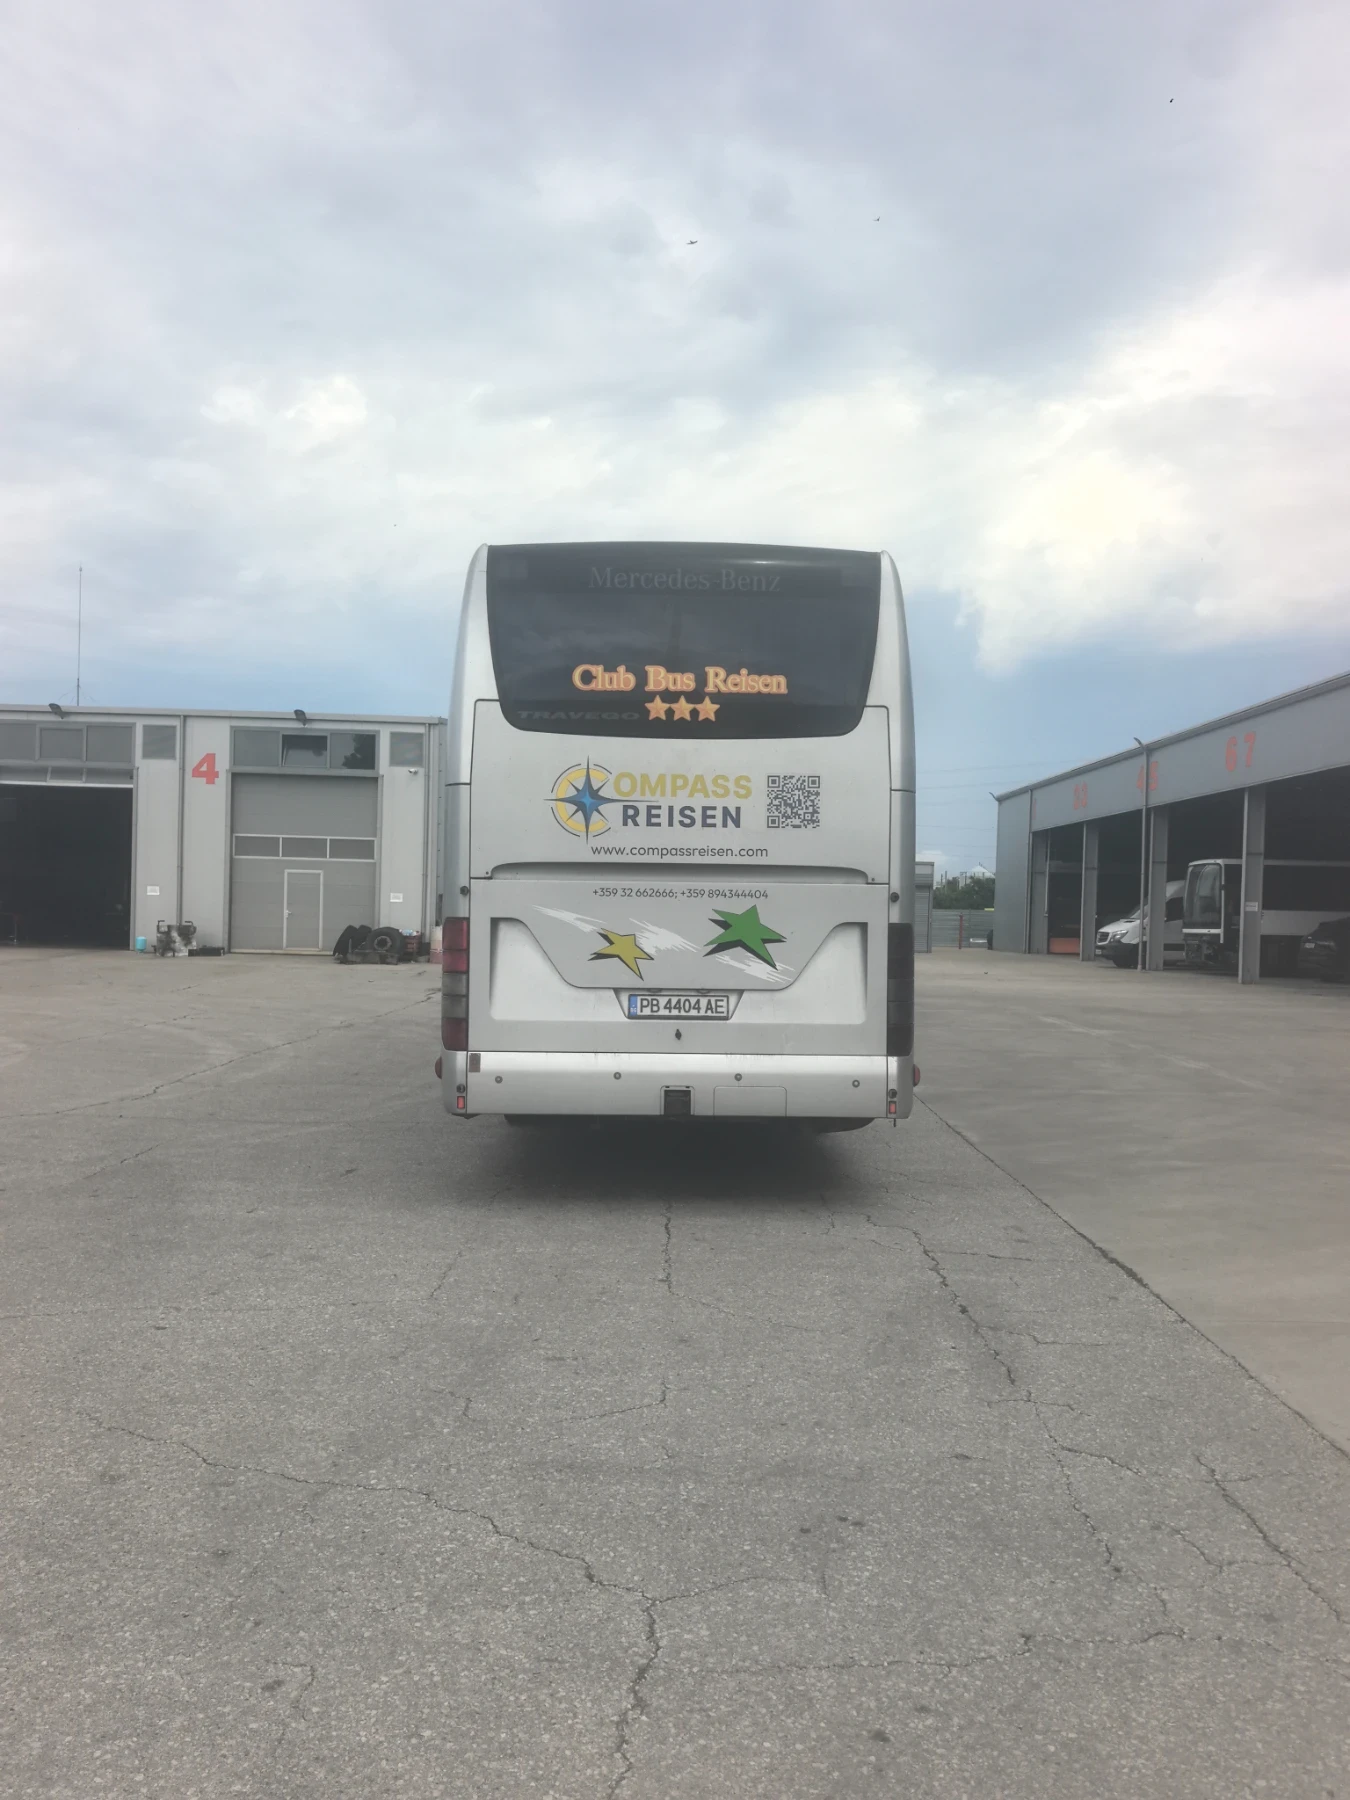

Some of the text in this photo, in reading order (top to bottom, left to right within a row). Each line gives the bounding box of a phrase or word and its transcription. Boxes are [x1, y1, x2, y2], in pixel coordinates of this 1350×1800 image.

[587, 566, 781, 592] Mercedes-Benz
[572, 663, 788, 695] Club Bus Reisen
[517, 710, 640, 721] TRAVEGO
[191, 752, 220, 785] 4
[621, 804, 742, 829] REISEN
[591, 844, 769, 859] www.compassreisen.com
[592, 887, 618, 898] +359
[620, 887, 633, 898] 32
[680, 888, 706, 899] +359
[707, 889, 769, 900] 894344404
[640, 998, 725, 1014] PB 4404 AE
